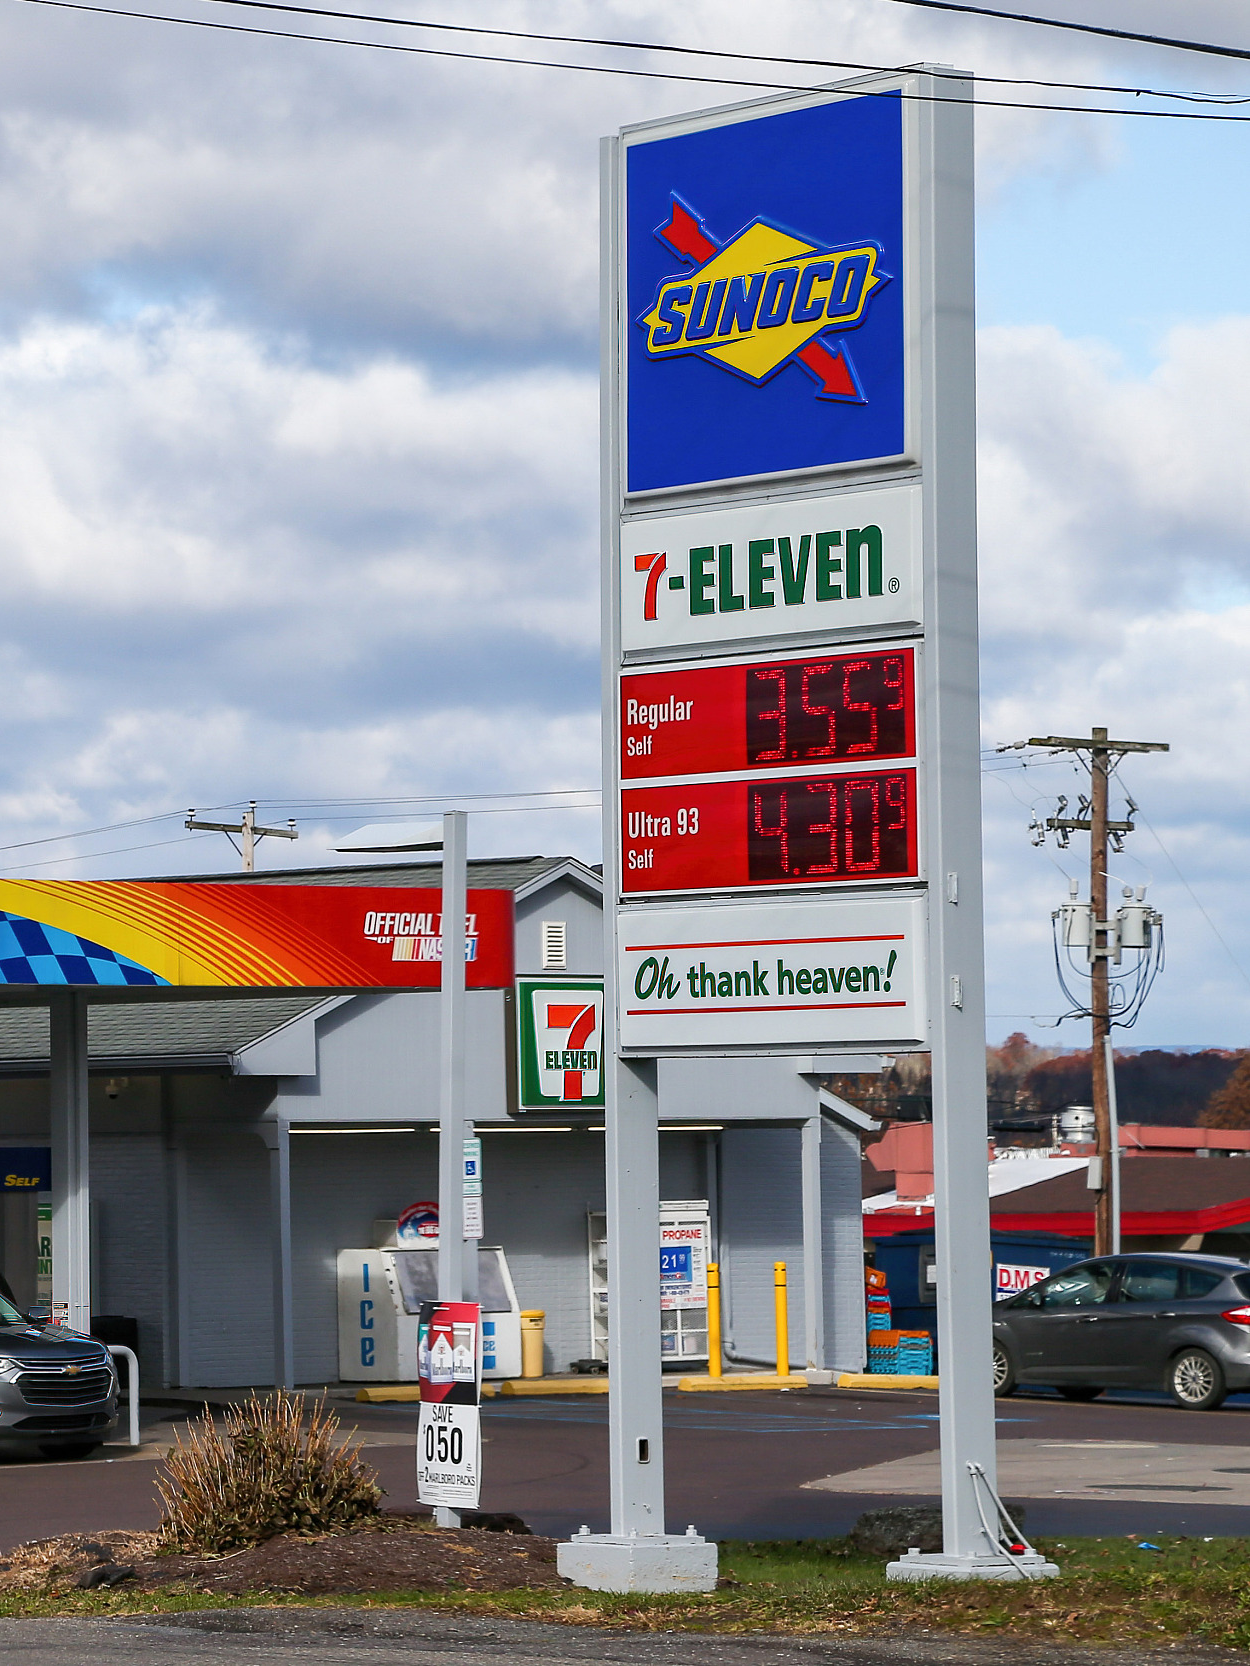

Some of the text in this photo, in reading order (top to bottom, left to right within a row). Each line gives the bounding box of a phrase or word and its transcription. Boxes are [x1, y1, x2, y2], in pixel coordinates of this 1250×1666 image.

[652, 254, 871, 347] SUNOCO
[626, 697, 694, 730] Regular
[627, 736, 652, 757] Self
[627, 812, 671, 839] Ultra
[676, 809, 700, 835] 93
[628, 849, 654, 870] Self
[363, 911, 436, 936] OFFICIAL
[634, 950, 898, 1000] Oh thank heaven!
[546, 1003, 596, 1101] 7
[662, 1229, 702, 1240] PROPANE
[432, 1405, 453, 1423] SAVE
[456, 1475, 475, 1487] PACKS
